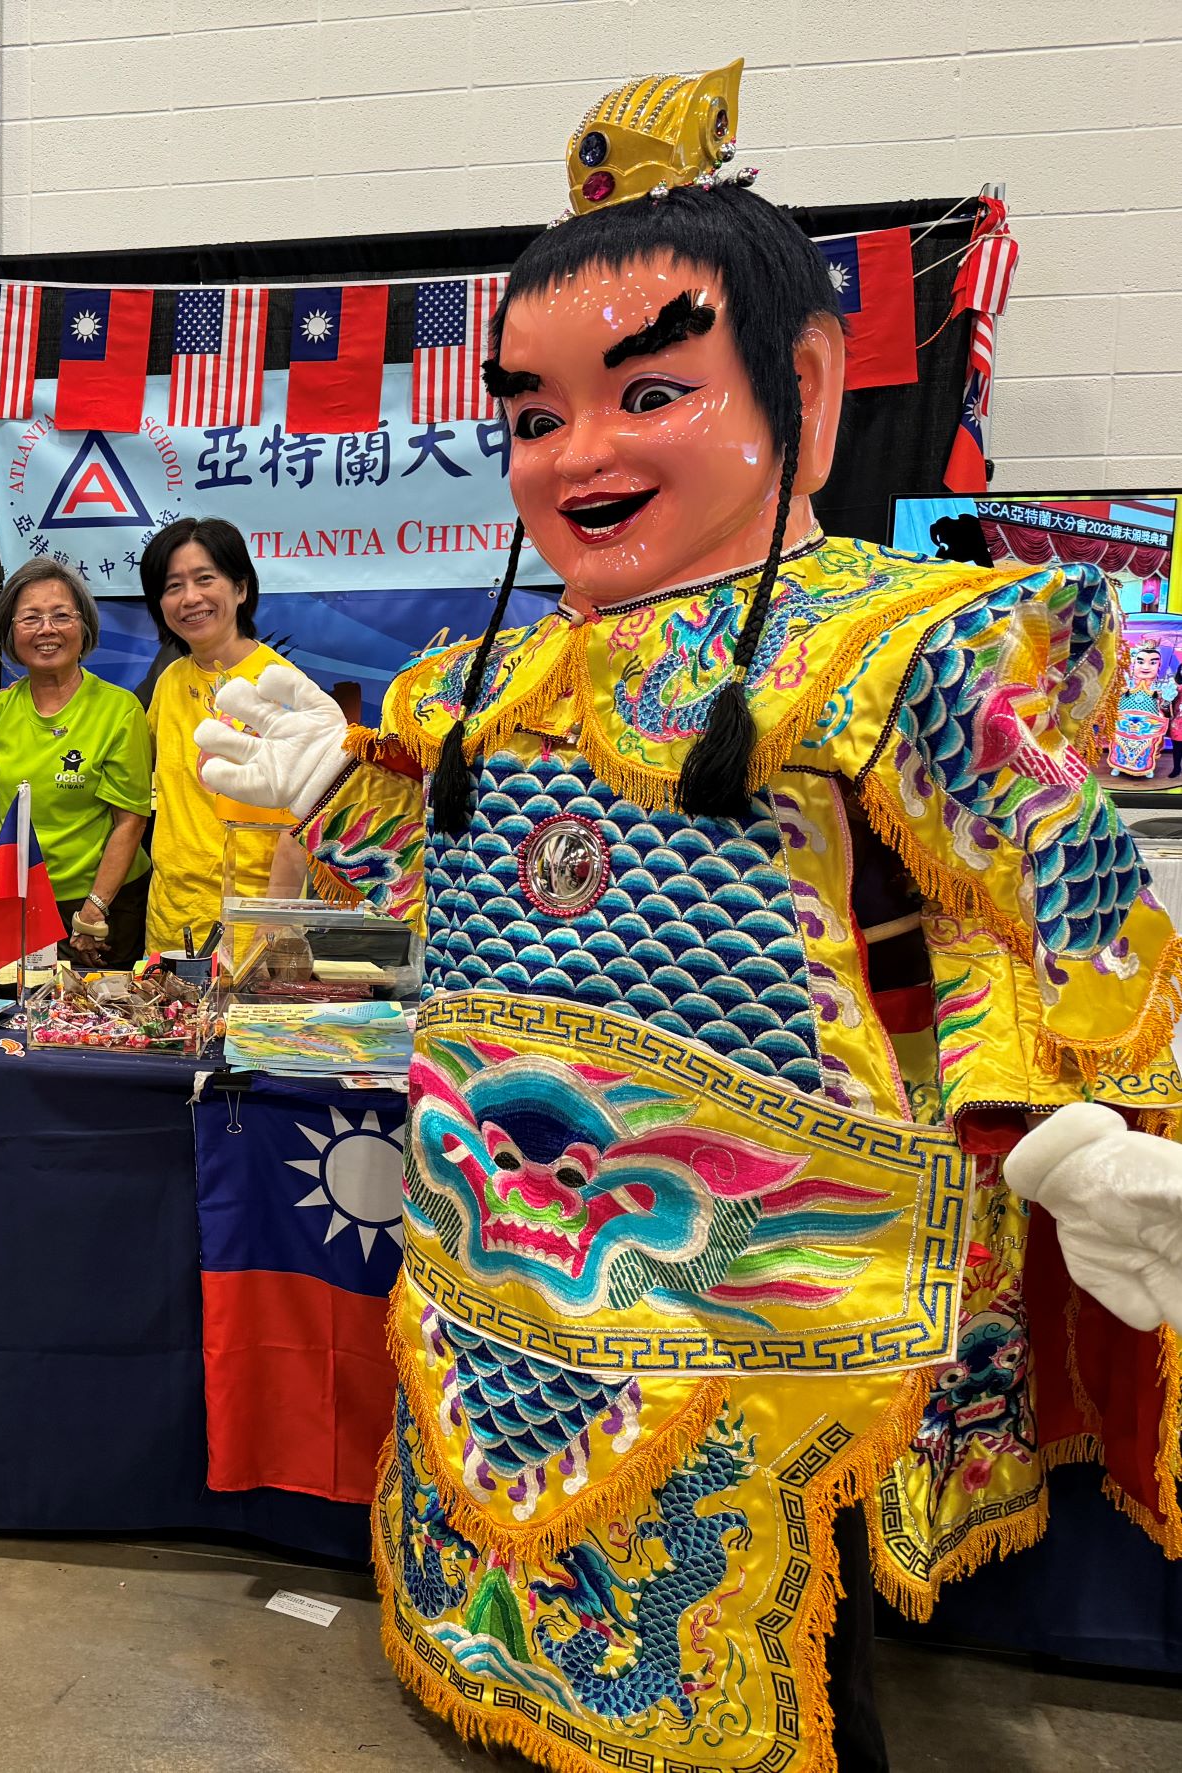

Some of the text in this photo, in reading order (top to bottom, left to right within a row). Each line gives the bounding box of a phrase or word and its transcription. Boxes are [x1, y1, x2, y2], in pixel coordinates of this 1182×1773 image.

[9, 413, 55, 494] ATLANTA
[140, 416, 183, 492] SCHOOL
[250, 527, 386, 559] TLANTA
